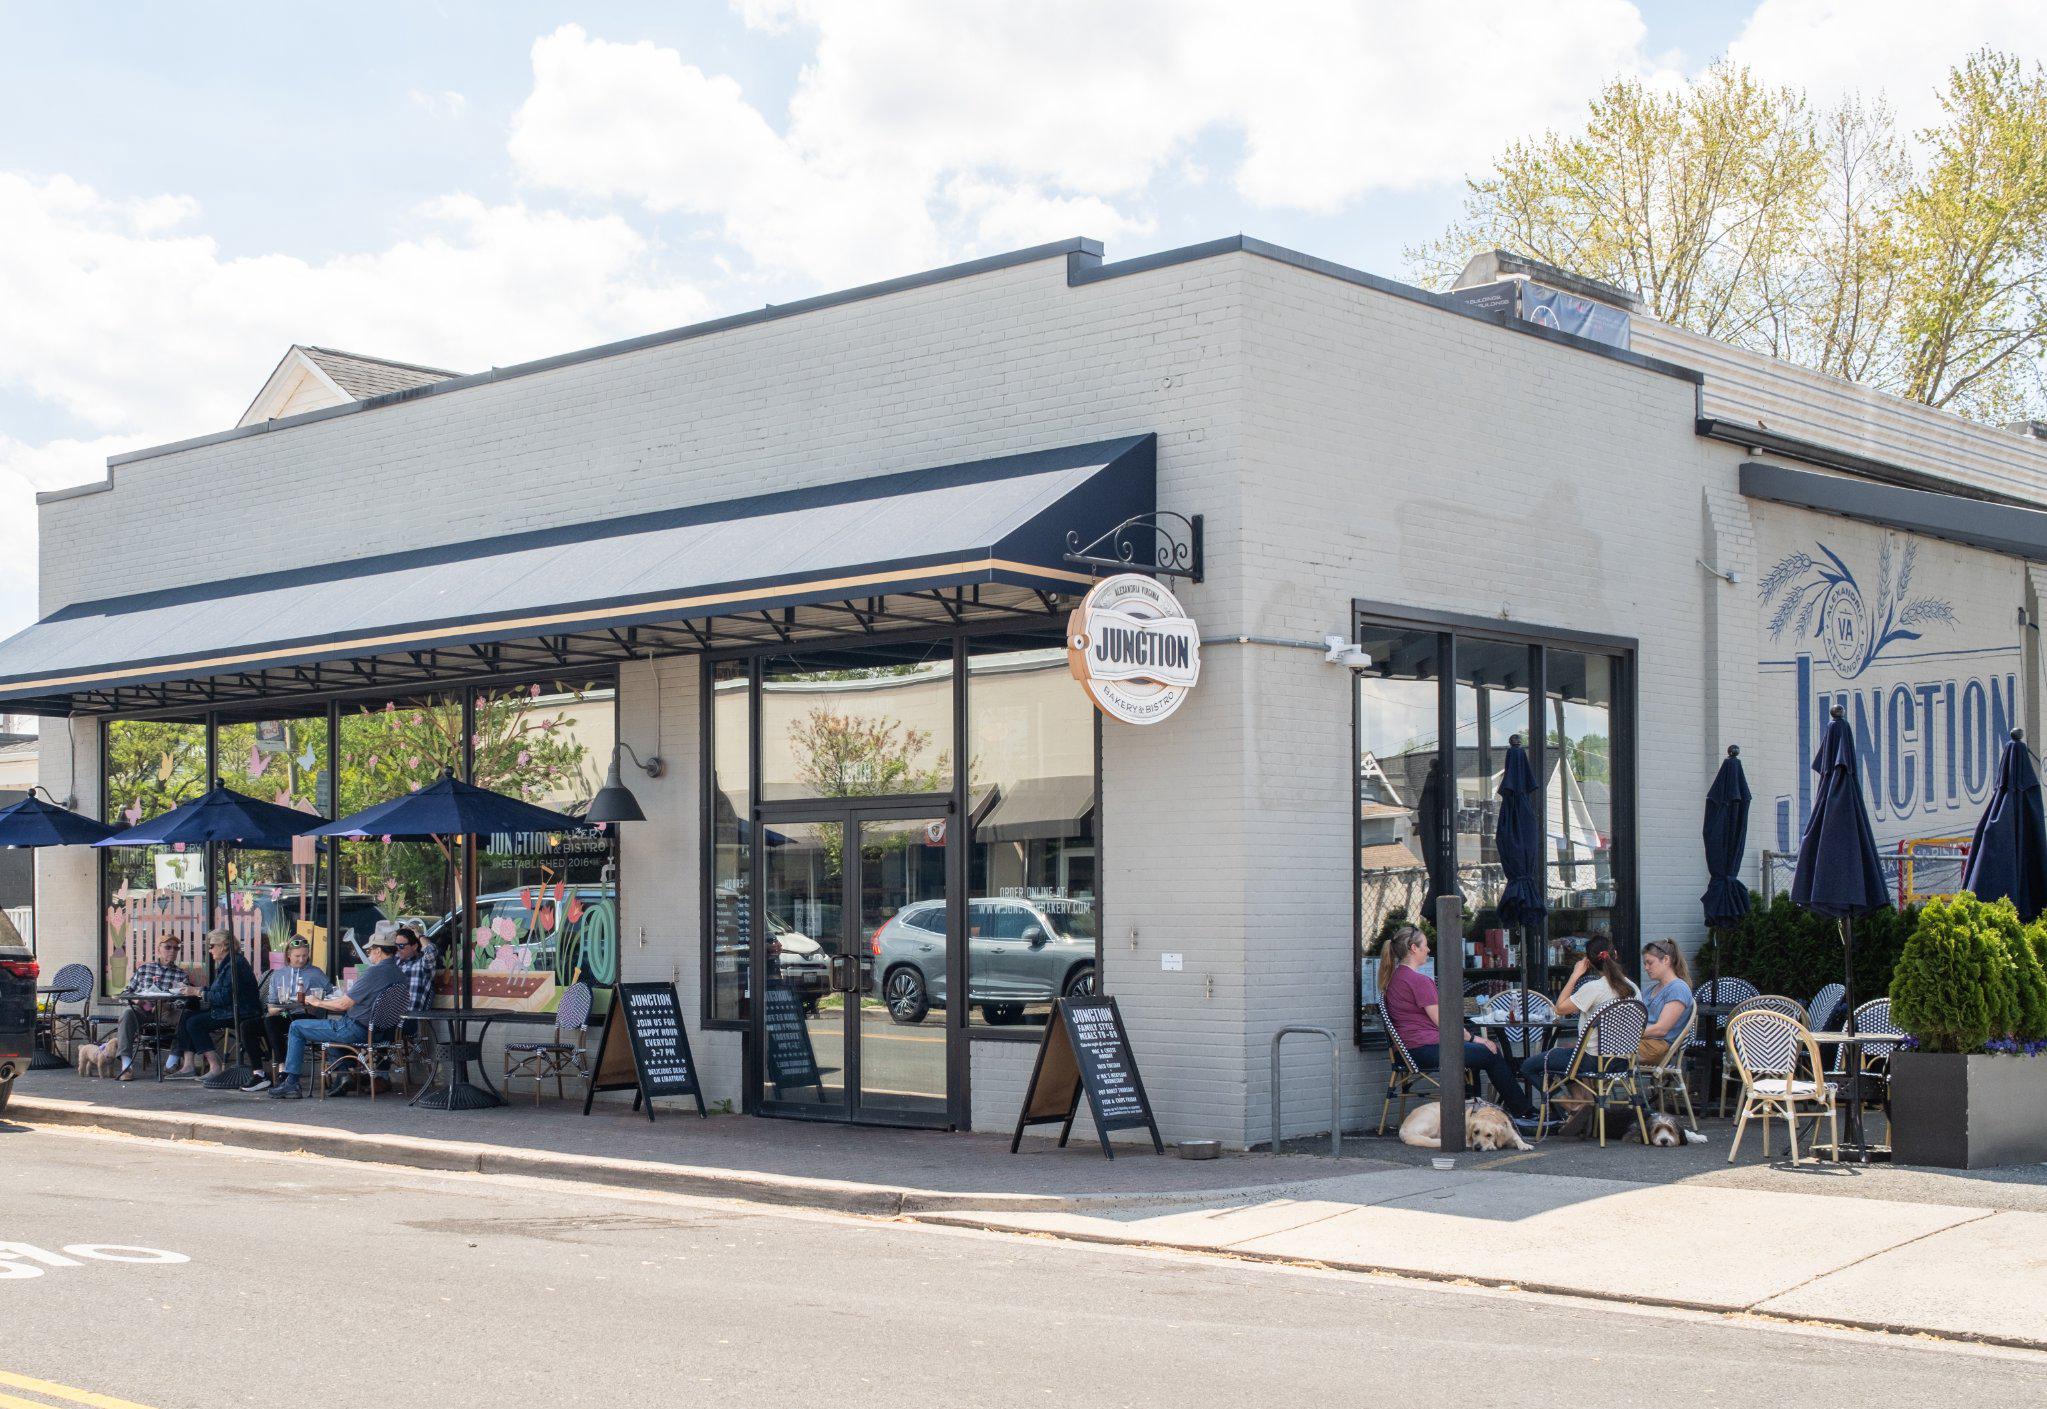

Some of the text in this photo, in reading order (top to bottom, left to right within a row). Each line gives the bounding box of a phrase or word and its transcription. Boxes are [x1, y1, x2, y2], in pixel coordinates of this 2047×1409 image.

[1114, 584, 1160, 601] ALEXANDRIA VIRGINIA
[1827, 587, 1864, 621] ALEXANDRIA
[1838, 618, 1853, 641] VA
[1096, 627, 1189, 669] JUNCTION
[1103, 685, 1137, 713] BAKERY
[1145, 691, 1174, 714] BISTRO
[1776, 652, 2016, 868] JNCTION
[486, 832, 553, 856] JUNCTION
[563, 842, 606, 854] BISTRO
[502, 858, 589, 869] ESTABLISHED 2016
[1000, 887, 1023, 898] ORDER
[1026, 886, 1053, 898] ONLINE
[630, 994, 672, 1007] JUNCTION
[1073, 1008, 1114, 1023] JUNCTION
[637, 1019, 652, 1027] JOIN
[654, 1019, 662, 1027] US
[1077, 1023, 1115, 1032] FAMILY STYLE
[638, 1029, 659, 1037] HAPPY
[1079, 1032, 1098, 1040] MEALS
[645, 1039, 676, 1047] EVERYDAY
[651, 1049, 664, 1057] 3-7
[653, 1075, 661, 1083] ON
